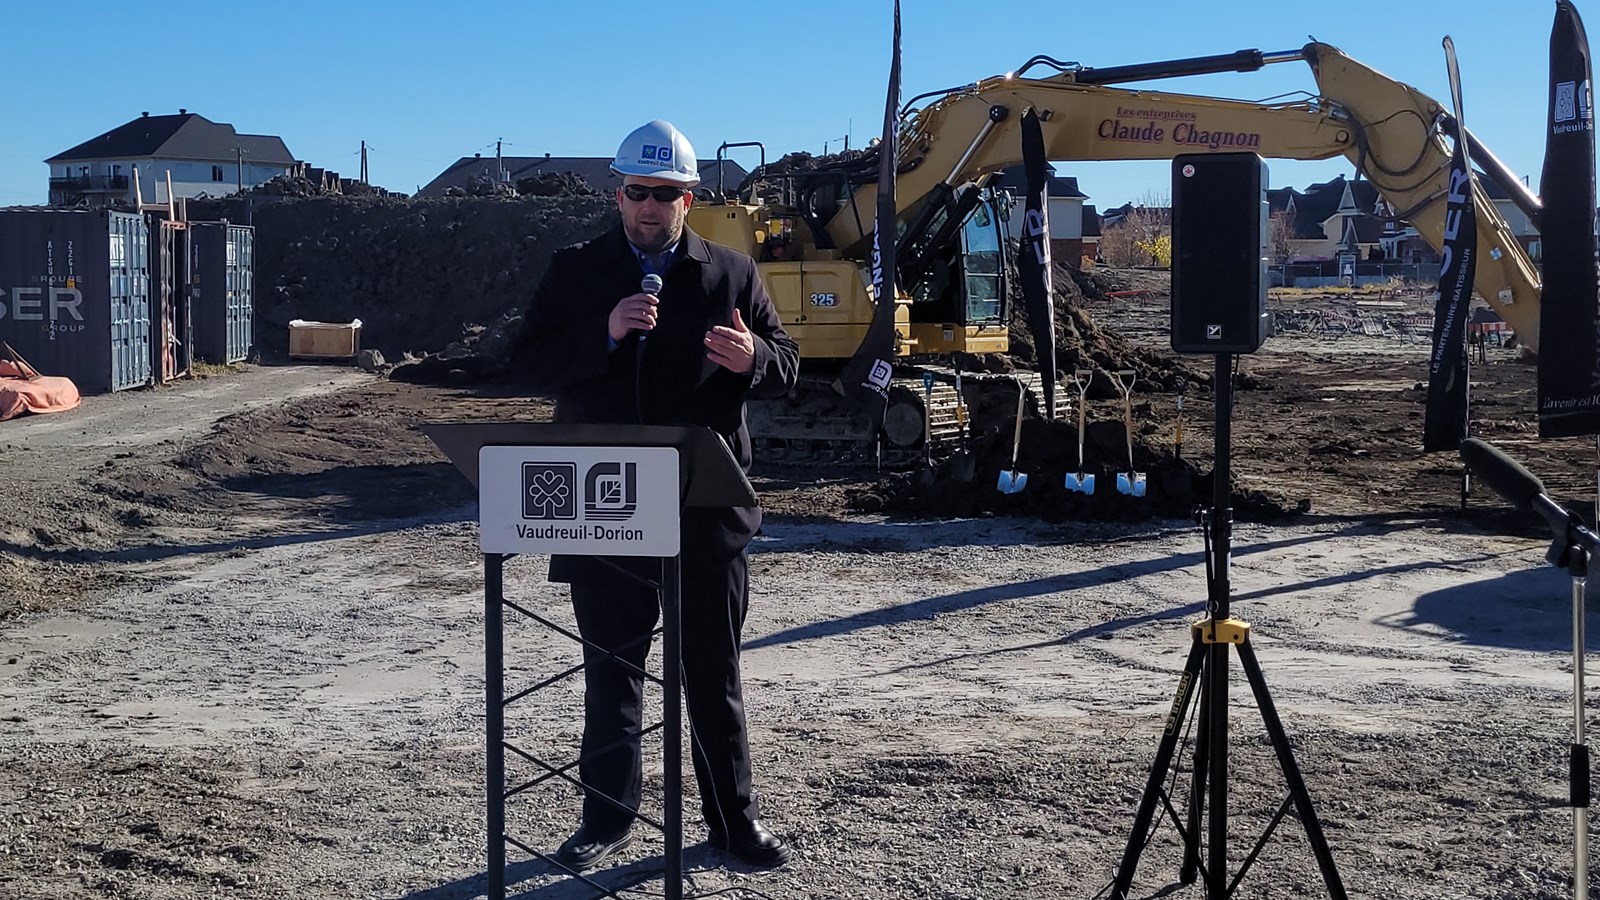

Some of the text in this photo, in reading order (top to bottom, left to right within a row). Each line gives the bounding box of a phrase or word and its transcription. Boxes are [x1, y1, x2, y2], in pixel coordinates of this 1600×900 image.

[1116, 106, 1197, 121] Les entreprises
[1098, 119, 1261, 151] Claude Chagnon
[0, 286, 84, 321] ER
[810, 293, 834, 306] 325
[1432, 362, 1440, 374] LE
[516, 524, 643, 541] Vaudreuil-Dorion
